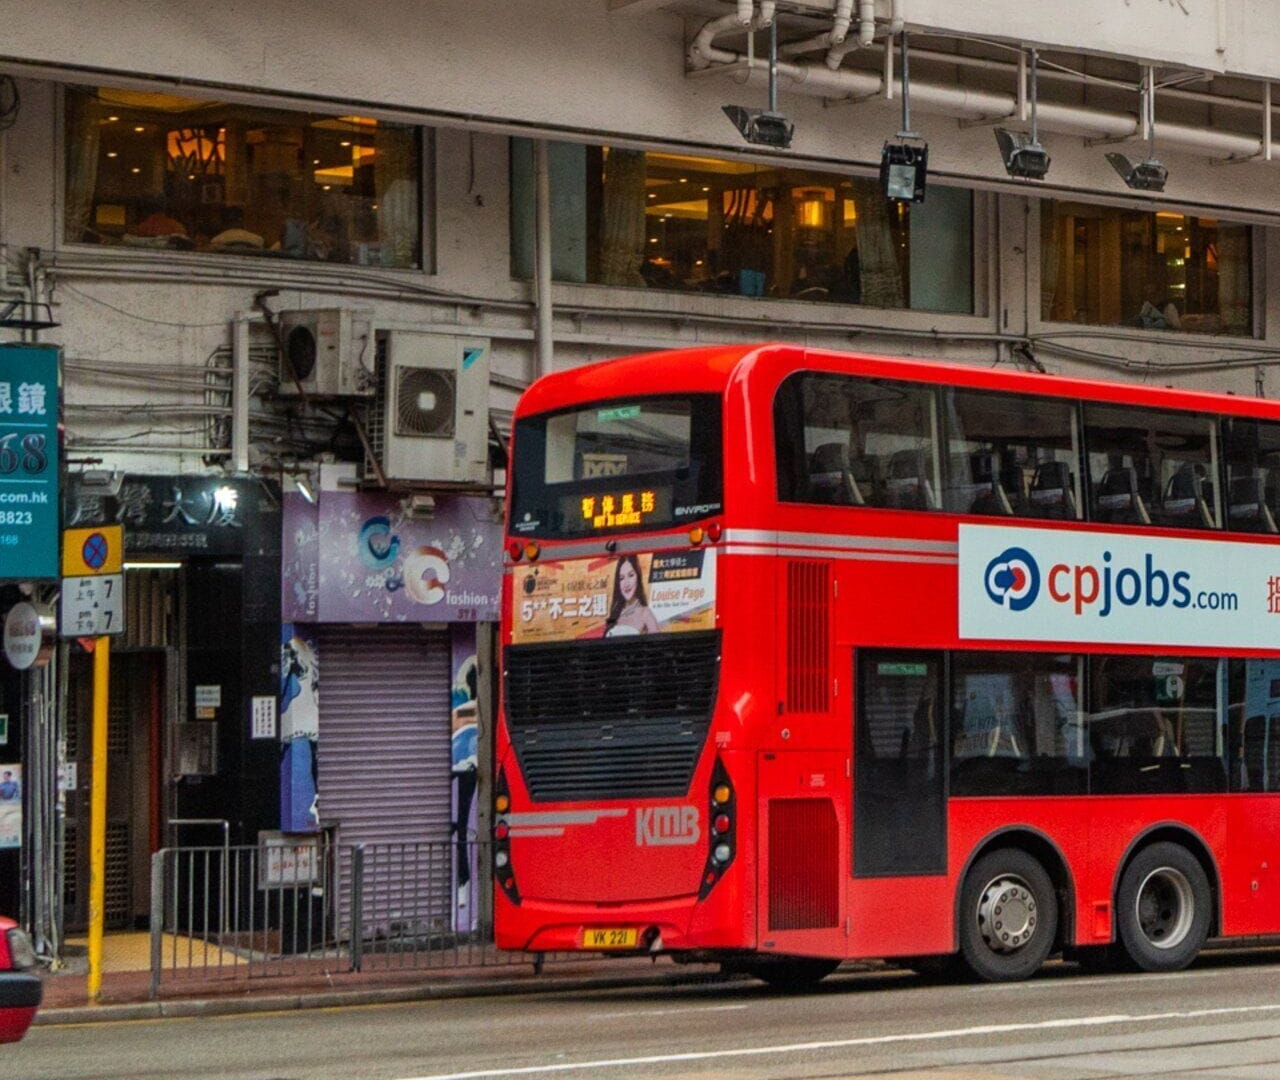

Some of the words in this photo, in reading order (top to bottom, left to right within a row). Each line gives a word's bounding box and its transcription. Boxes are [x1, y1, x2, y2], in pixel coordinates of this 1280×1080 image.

[104, 580, 114, 599] 7
[1048, 551, 1239, 617] cpjobs.com
[104, 610, 113, 630] 7
[635, 806, 701, 846] KMB
[593, 932, 605, 944] VK
[610, 931, 628, 944] 221
